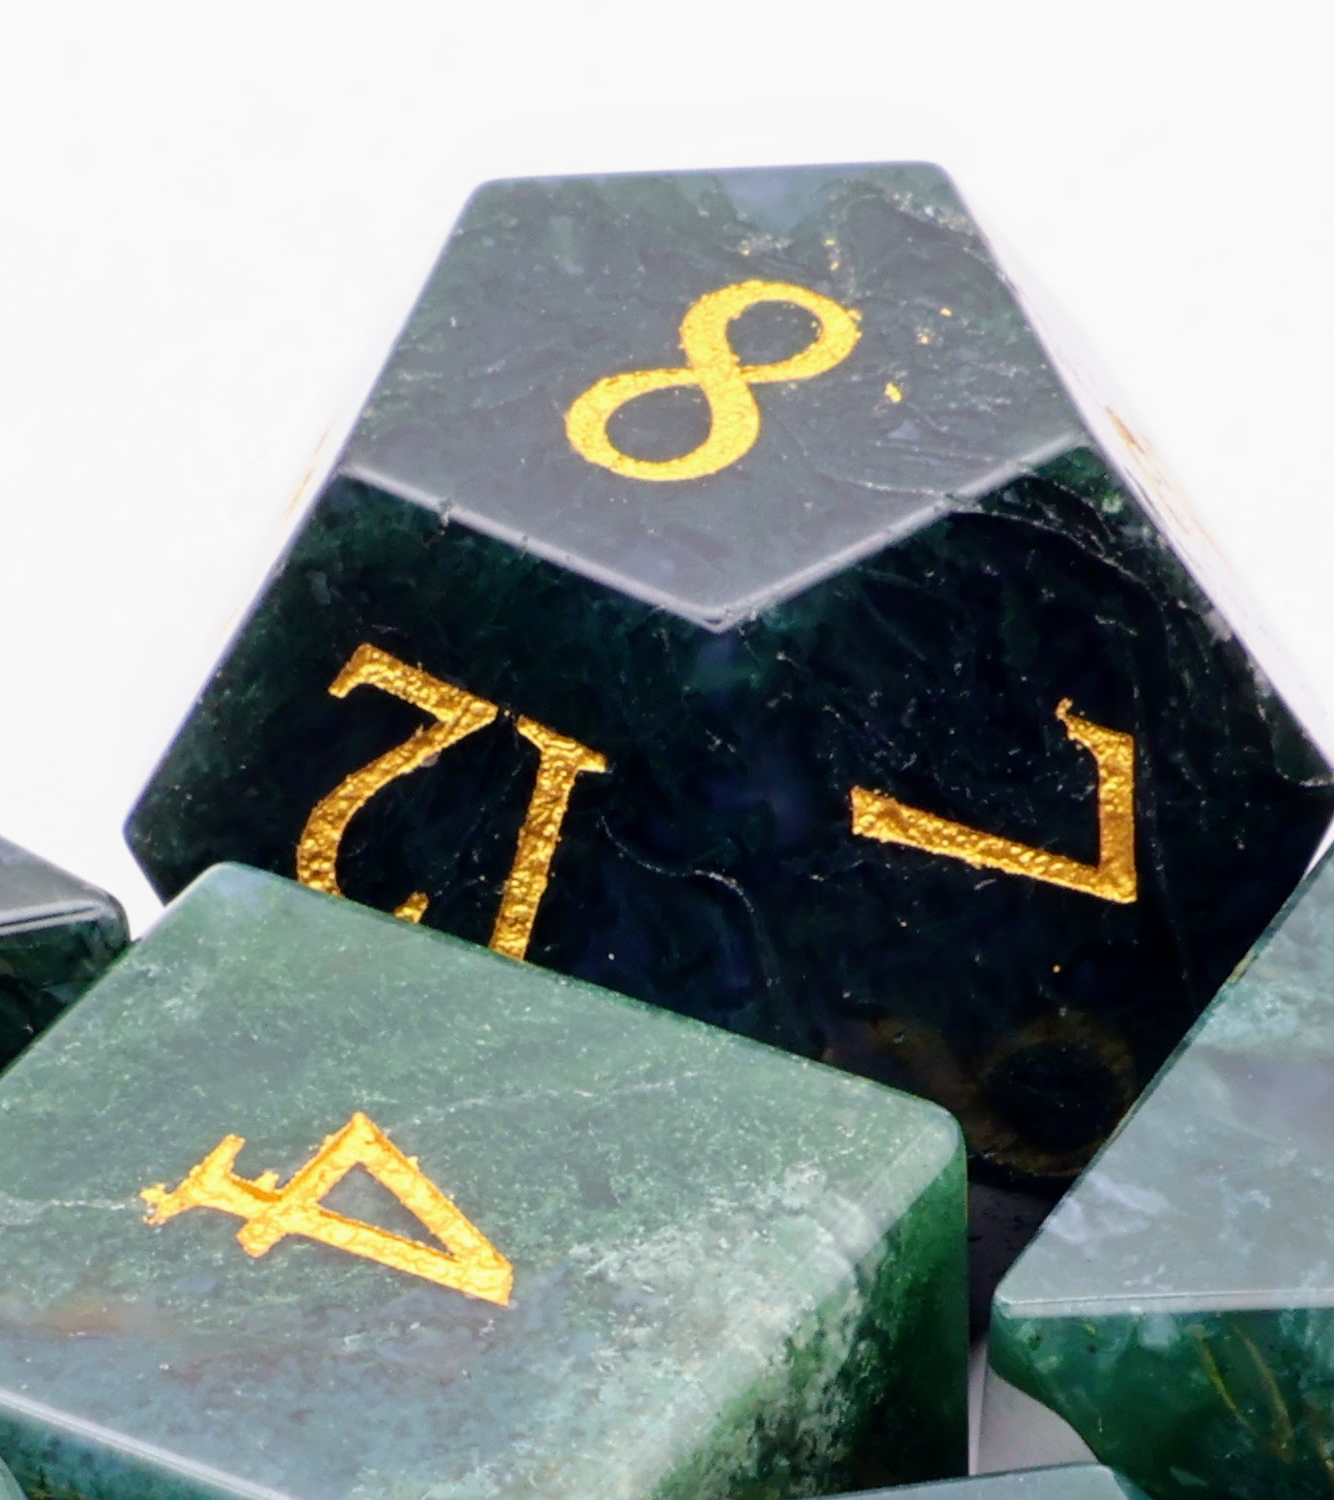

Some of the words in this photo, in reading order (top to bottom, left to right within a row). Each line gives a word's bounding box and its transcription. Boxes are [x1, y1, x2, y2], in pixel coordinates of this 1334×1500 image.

[563, 276, 863, 481] 8
[293, 640, 612, 964] 12
[848, 695, 1139, 906] 7
[141, 1112, 514, 1306] 4
